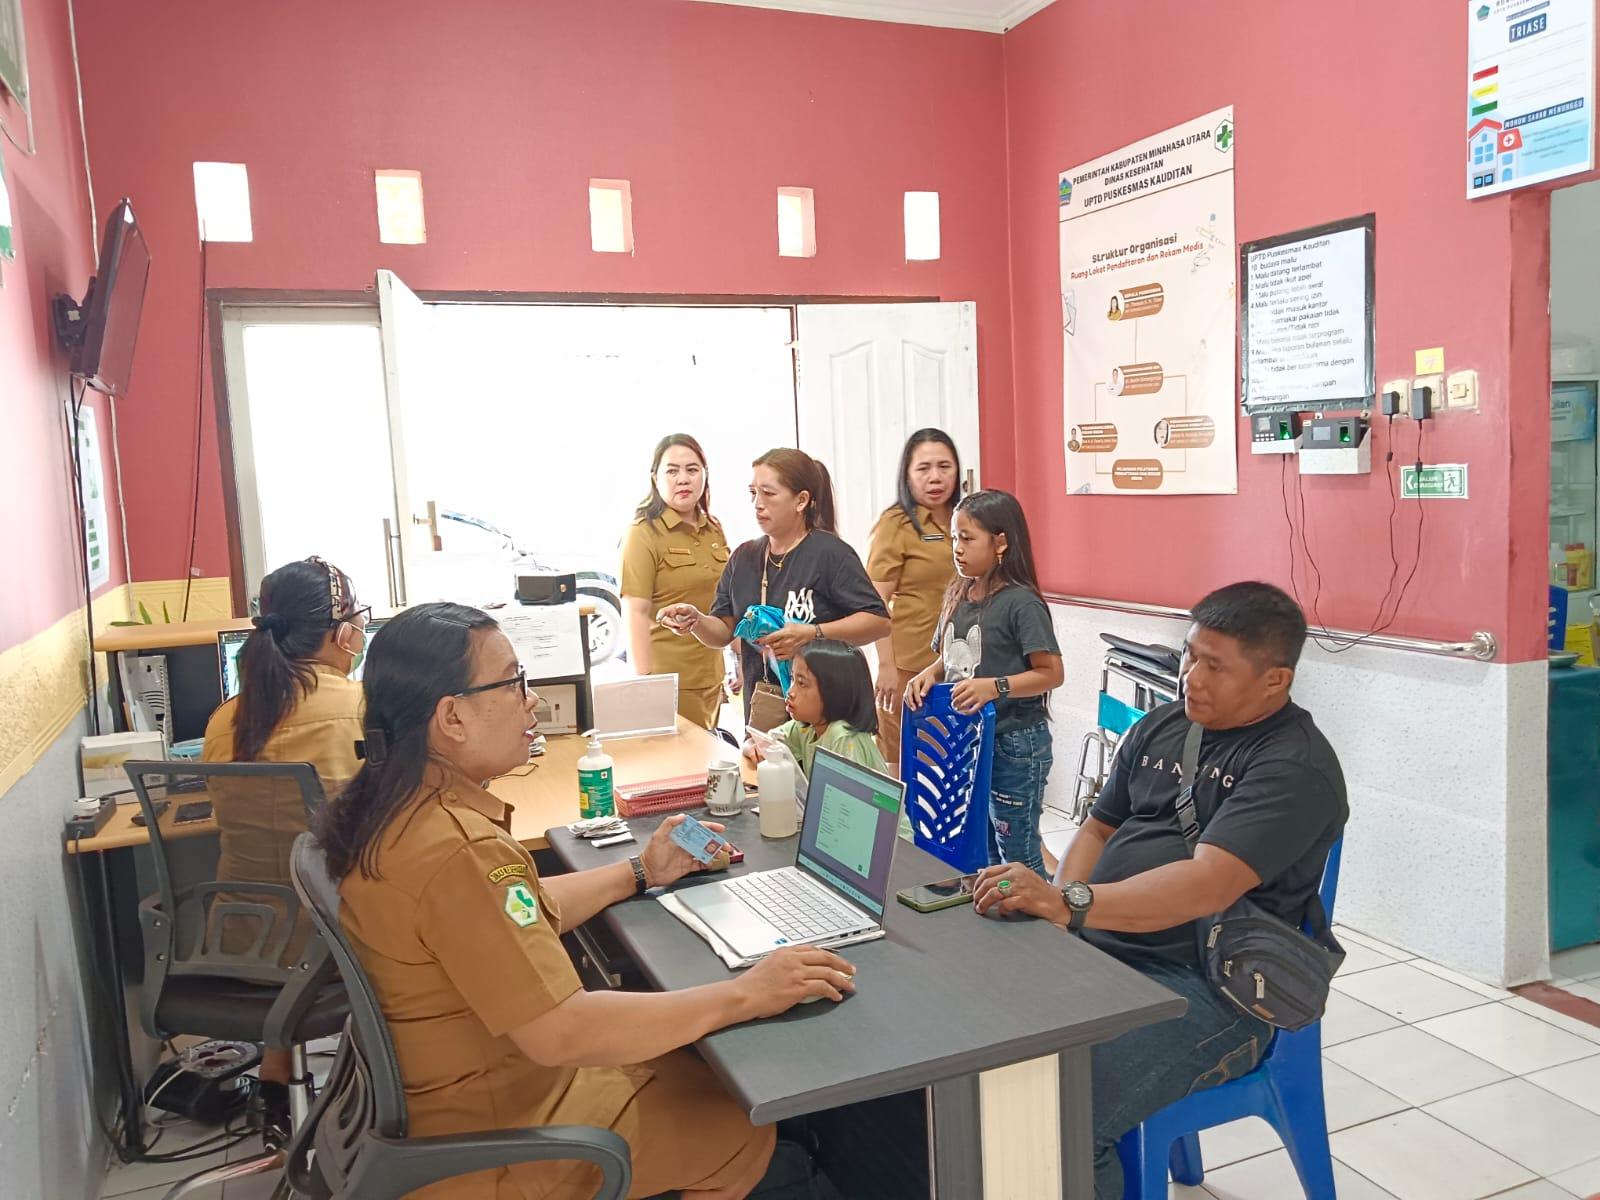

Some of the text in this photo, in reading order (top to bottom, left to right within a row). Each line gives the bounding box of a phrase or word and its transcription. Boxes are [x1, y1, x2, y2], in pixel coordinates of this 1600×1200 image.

[1511, 16, 1545, 40] TRIASE
[1073, 130, 1211, 185] PEMERINTAH KABUPATEN MINAHASA UTARA
[1104, 159, 1164, 186] DINAS KESEHATAN
[1084, 164, 1193, 207] UPTD PUSKESMAS KAUDITAN
[1092, 233, 1177, 263] Struktur Organisasi
[1250, 239, 1331, 262] UPTD Puskesmas Kauditan
[1071, 269, 1088, 280] Ruang
[1089, 265, 1106, 276] Loket
[1146, 251, 1159, 262] dan
[1160, 246, 1182, 260] Rekam
[1255, 272, 1269, 280] Malu
[1291, 261, 1323, 273] terlambat
[1281, 257, 1298, 265] malu
[1307, 300, 1328, 309] kantor
[1330, 357, 1355, 367] dengan
